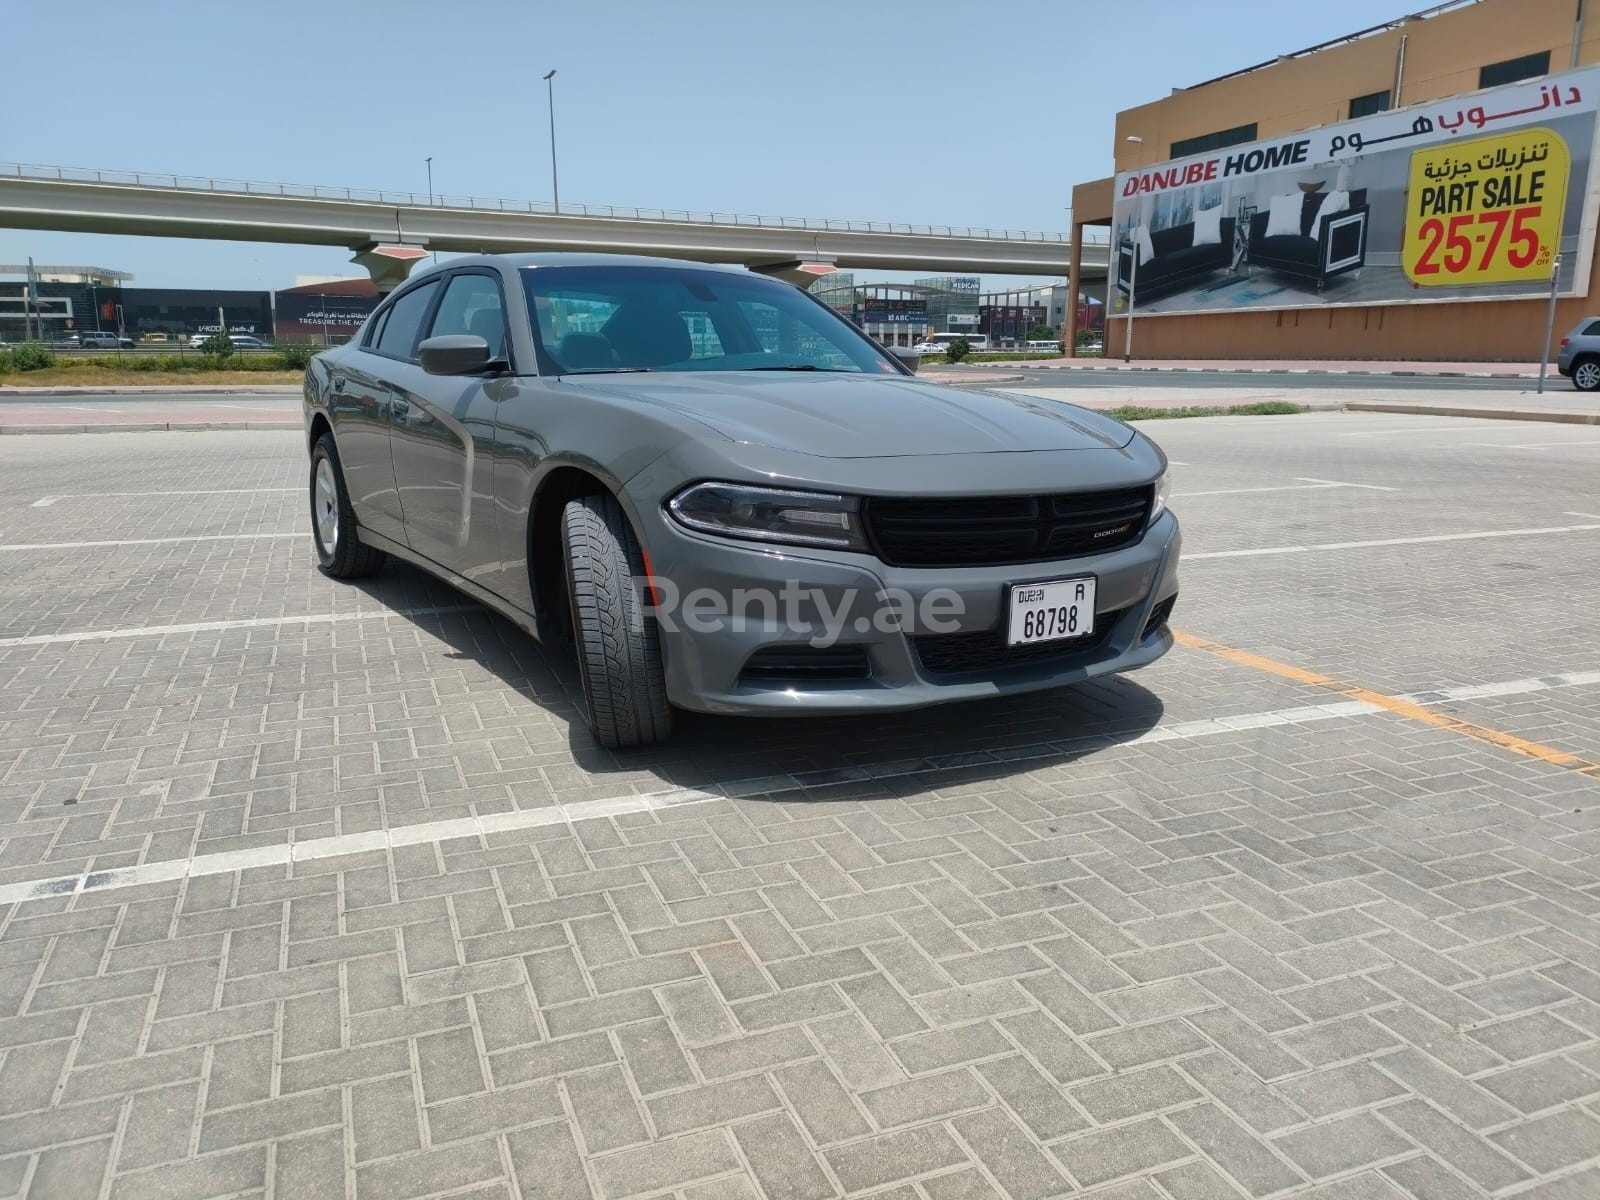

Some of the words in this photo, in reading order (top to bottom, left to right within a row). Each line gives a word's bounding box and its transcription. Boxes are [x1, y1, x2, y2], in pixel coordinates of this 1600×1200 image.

[1438, 85, 1582, 134] دانوب
[1329, 115, 1434, 157] هوم
[1123, 159, 1220, 197] DANUBE
[1223, 139, 1310, 177] HOME
[1424, 157, 1472, 182] جزئية
[1477, 143, 1549, 172] تنزيلات
[1420, 180, 1480, 217] PART
[1482, 170, 1546, 209] SALE
[1413, 206, 1542, 276] 25-75
[1536, 258, 1550, 266] OFF
[1093, 526, 1126, 538] DODGE
[1023, 605, 1078, 639] 68798
